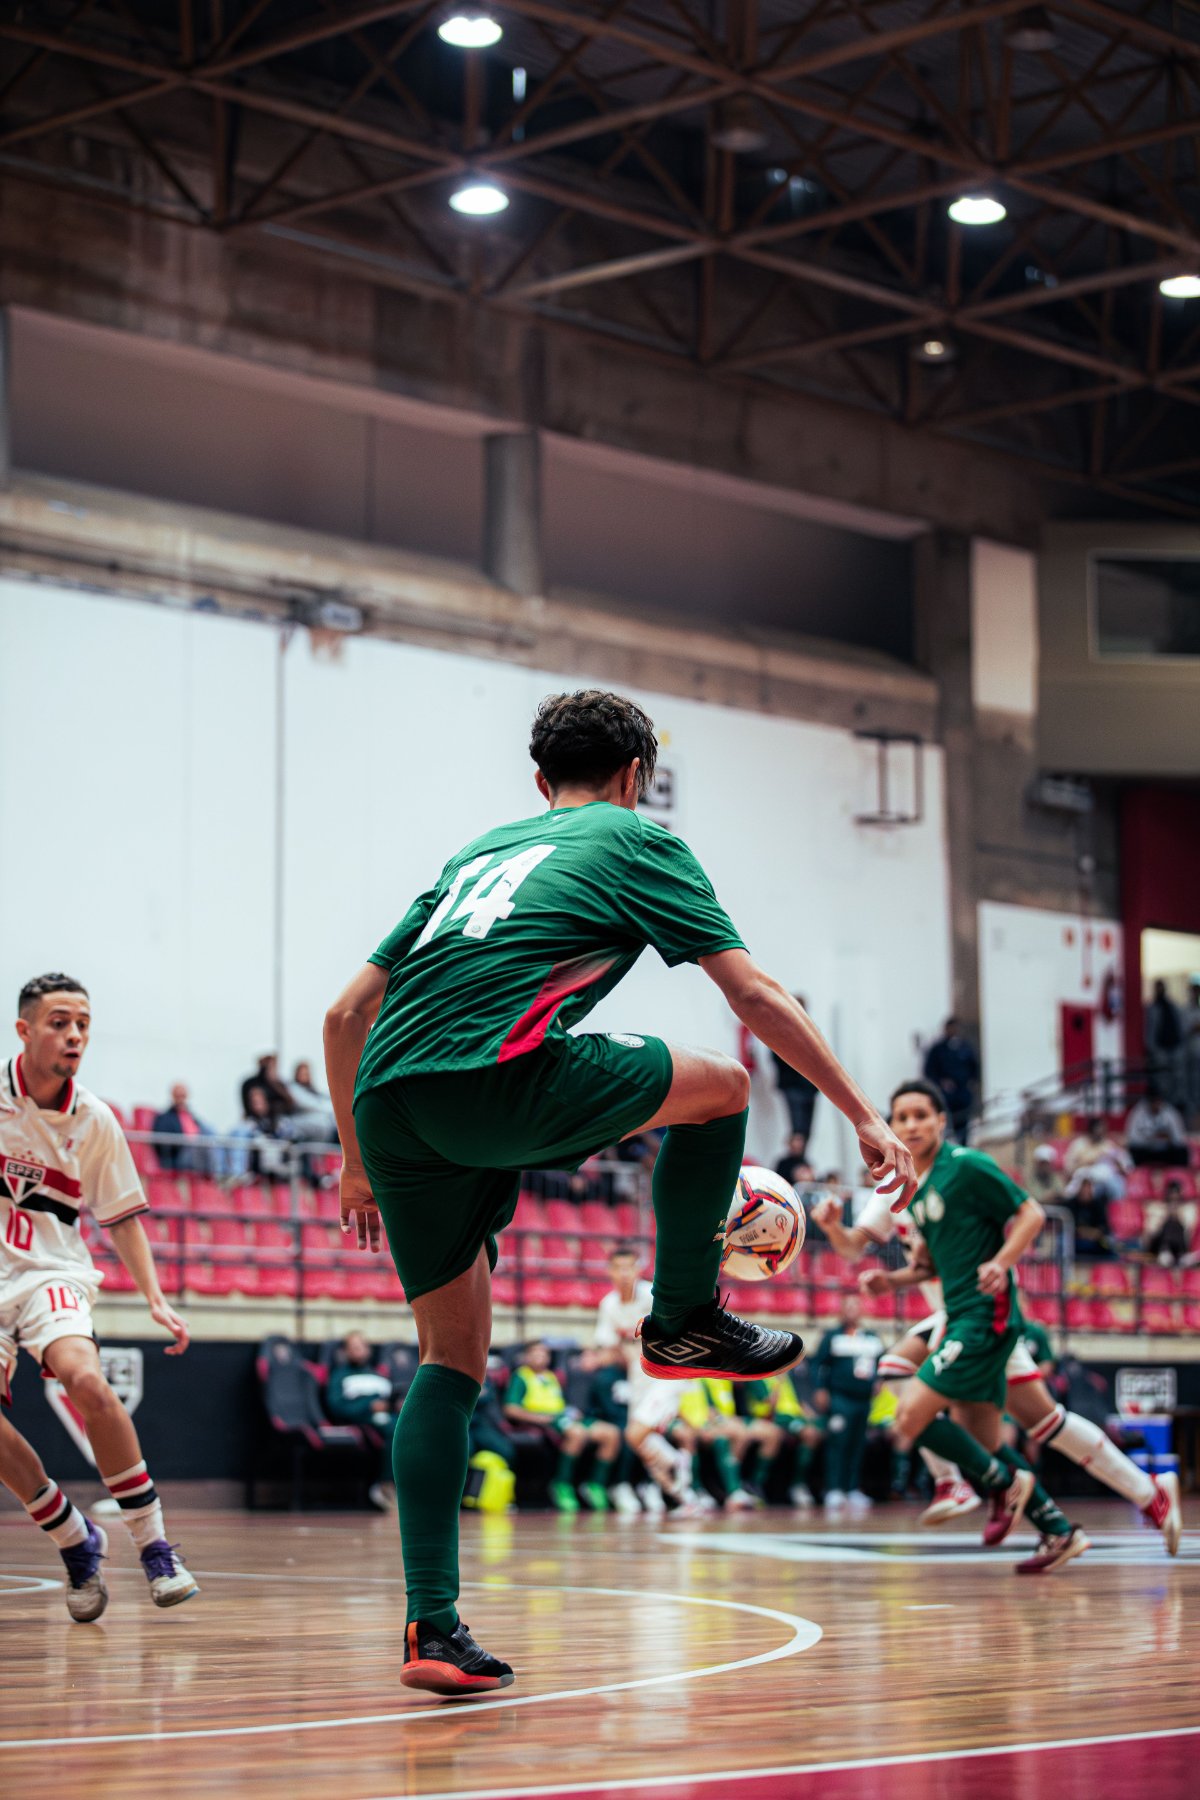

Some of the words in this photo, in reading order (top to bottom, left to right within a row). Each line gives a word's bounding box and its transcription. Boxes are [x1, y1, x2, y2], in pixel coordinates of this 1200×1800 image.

[414, 844, 557, 951] 14
[7, 1161, 43, 1180] SPFC
[6, 1206, 33, 1251] 10
[47, 1286, 79, 1312] 10
